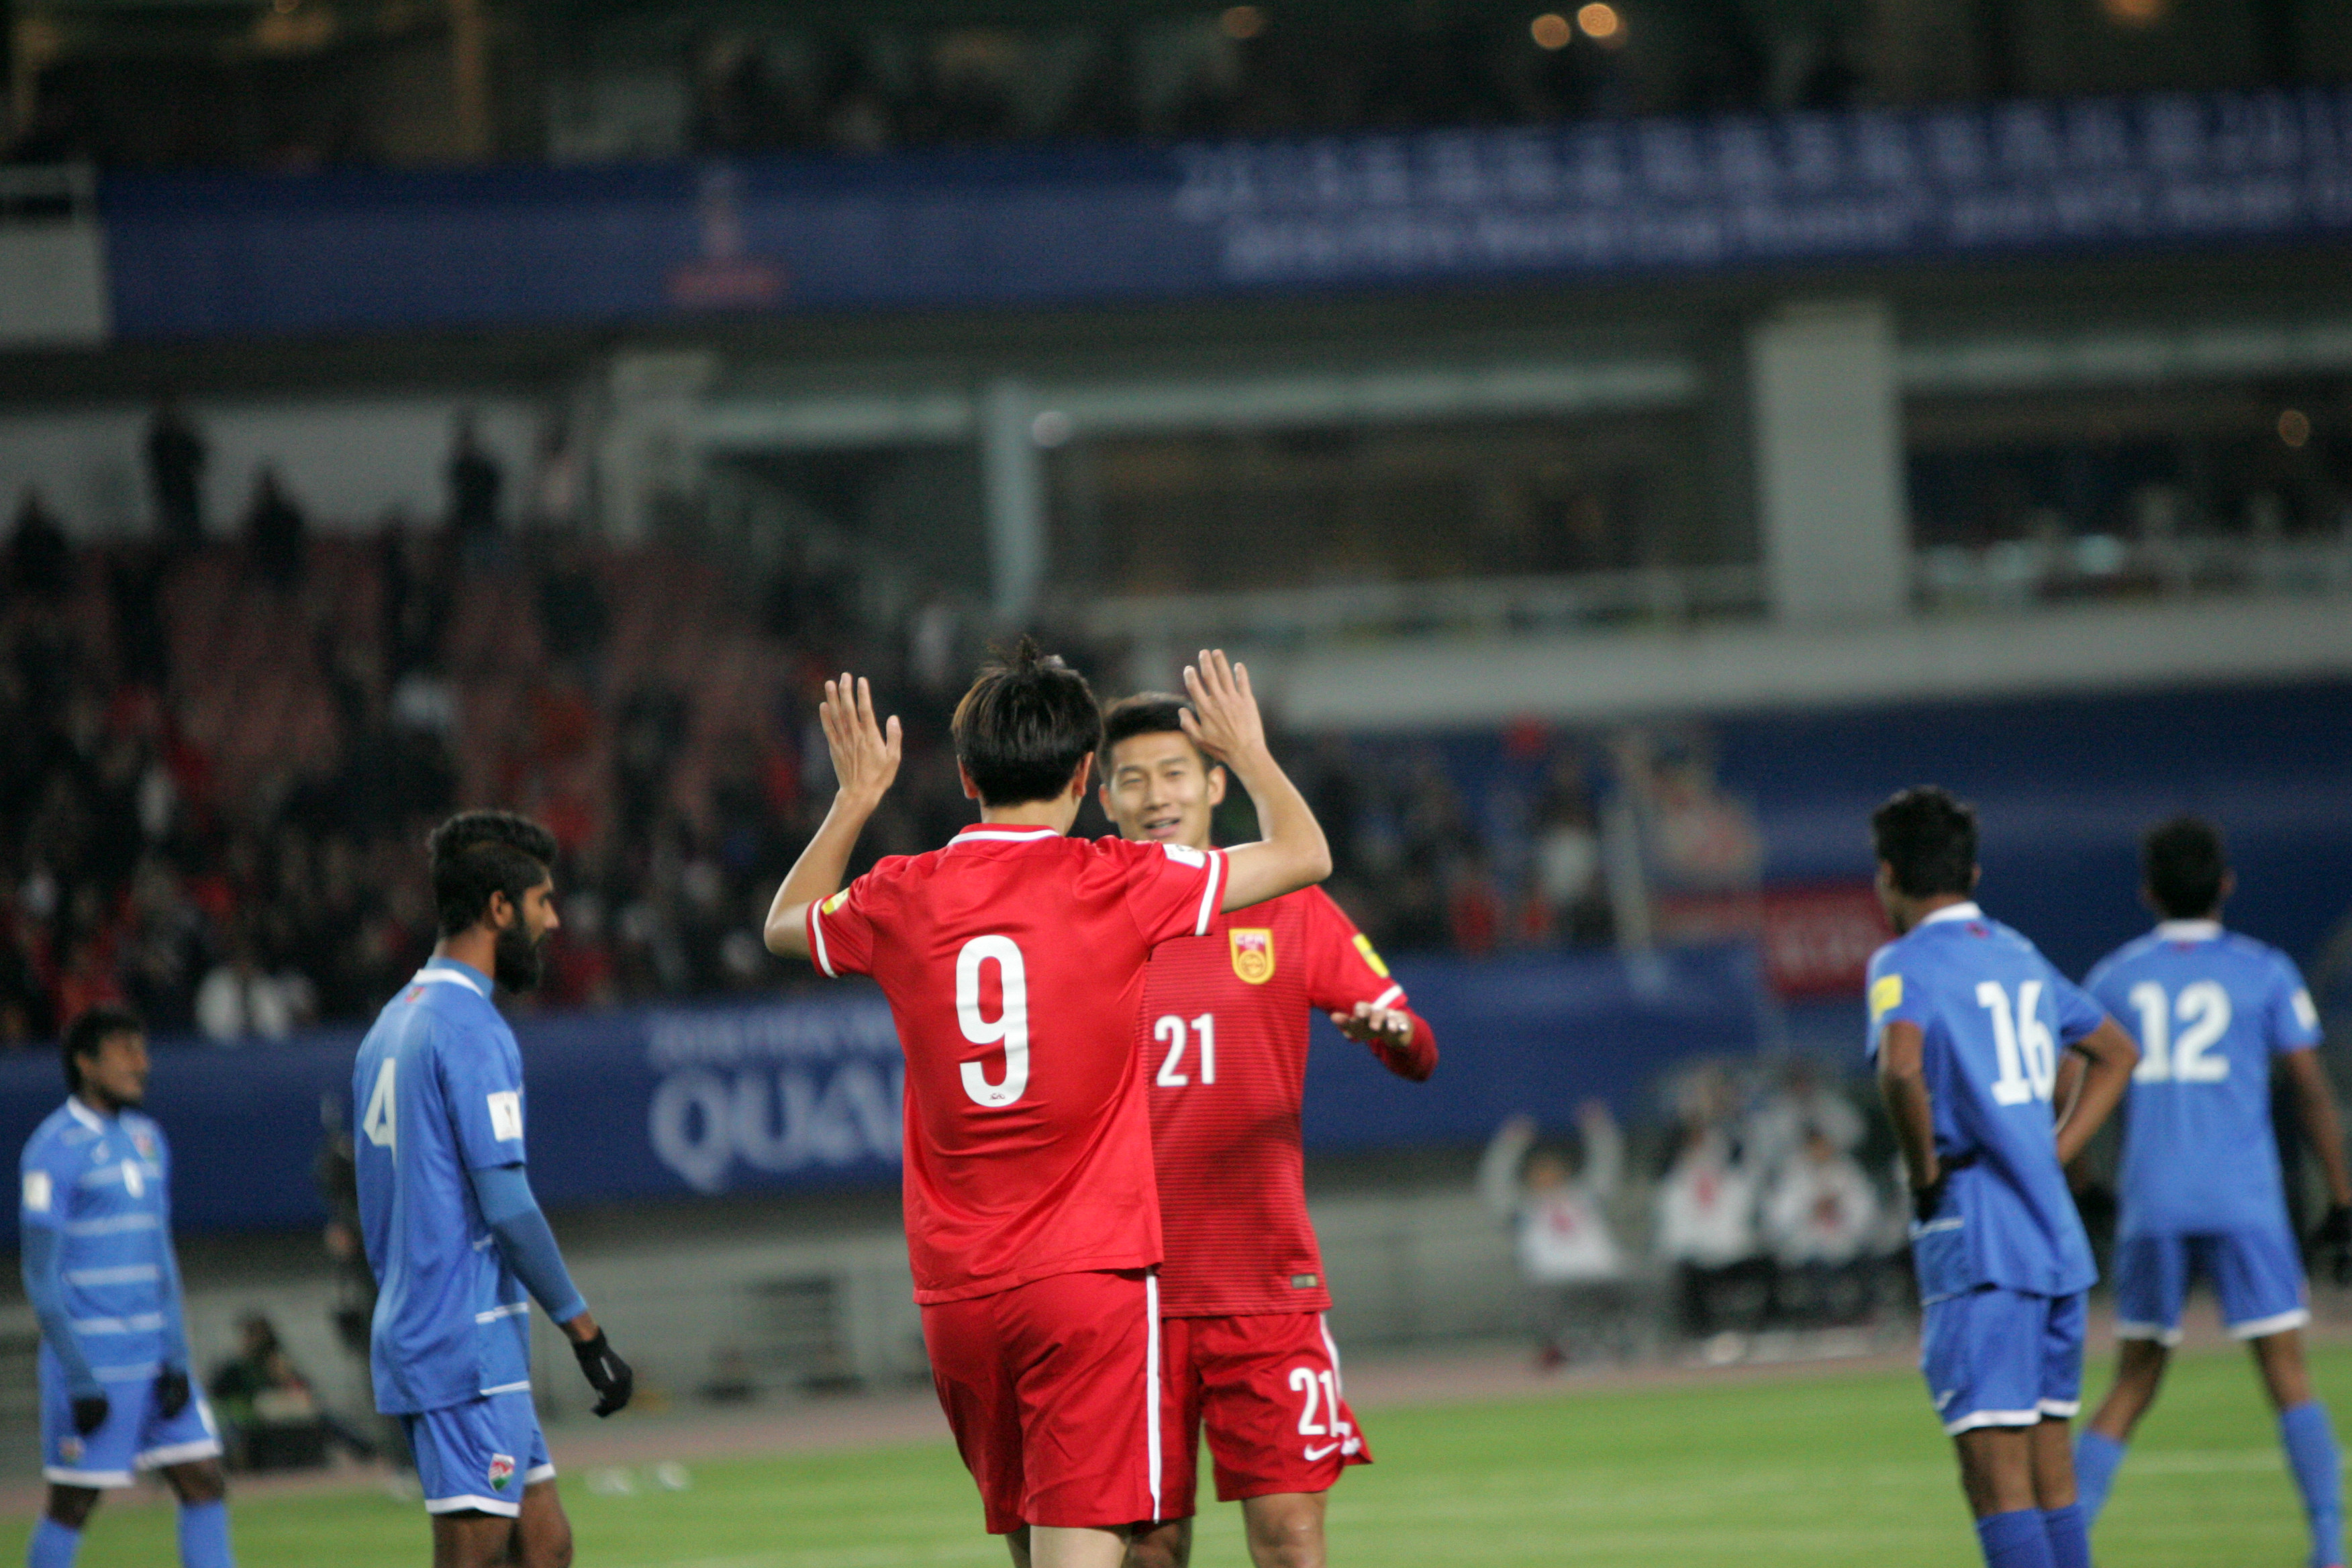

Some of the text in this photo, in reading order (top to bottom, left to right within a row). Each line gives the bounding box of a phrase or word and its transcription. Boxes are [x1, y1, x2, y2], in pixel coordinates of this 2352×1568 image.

[956, 934, 1029, 1107] 9
[1155, 1013, 1215, 1087] 21
[1975, 980, 2057, 1106] 16
[2129, 981, 2232, 1083] 12
[362, 1057, 397, 1169] 4
[648, 1066, 903, 1192] QUA
[1289, 1367, 1338, 1438] 21
